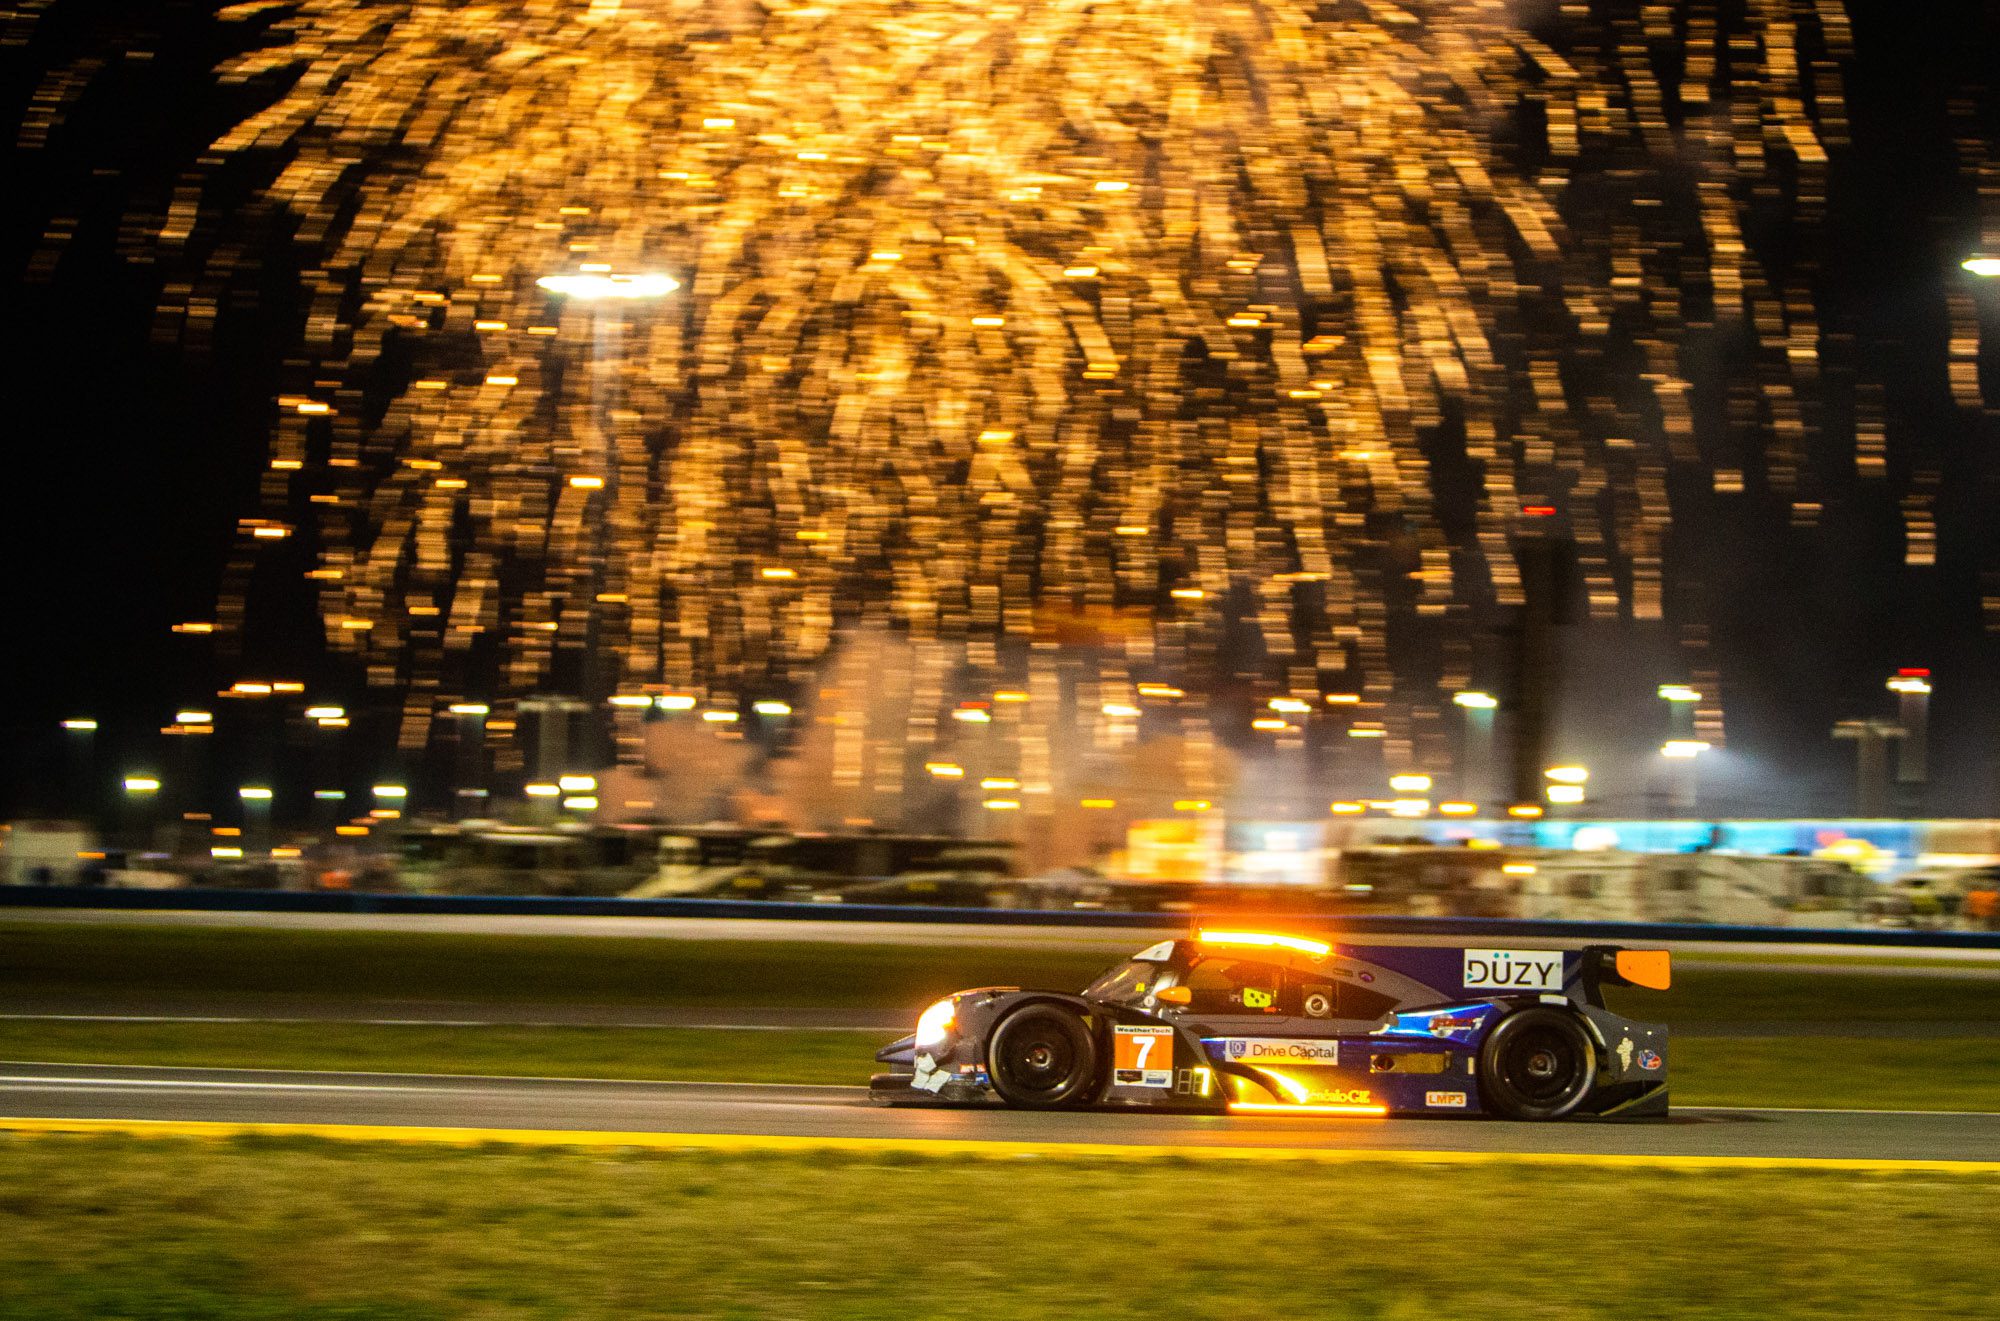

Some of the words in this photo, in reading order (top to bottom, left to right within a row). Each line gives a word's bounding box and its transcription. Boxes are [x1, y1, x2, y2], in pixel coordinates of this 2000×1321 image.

[1467, 952, 1555, 986] DÜZY
[1117, 1026, 1171, 1034] WeatherTech
[1132, 1036, 1156, 1069] 7
[1252, 1044, 1286, 1057] Drive
[1288, 1045, 1335, 1060] Capital
[1193, 1067, 1211, 1096] 7
[1428, 1094, 1464, 1105] LMP3
